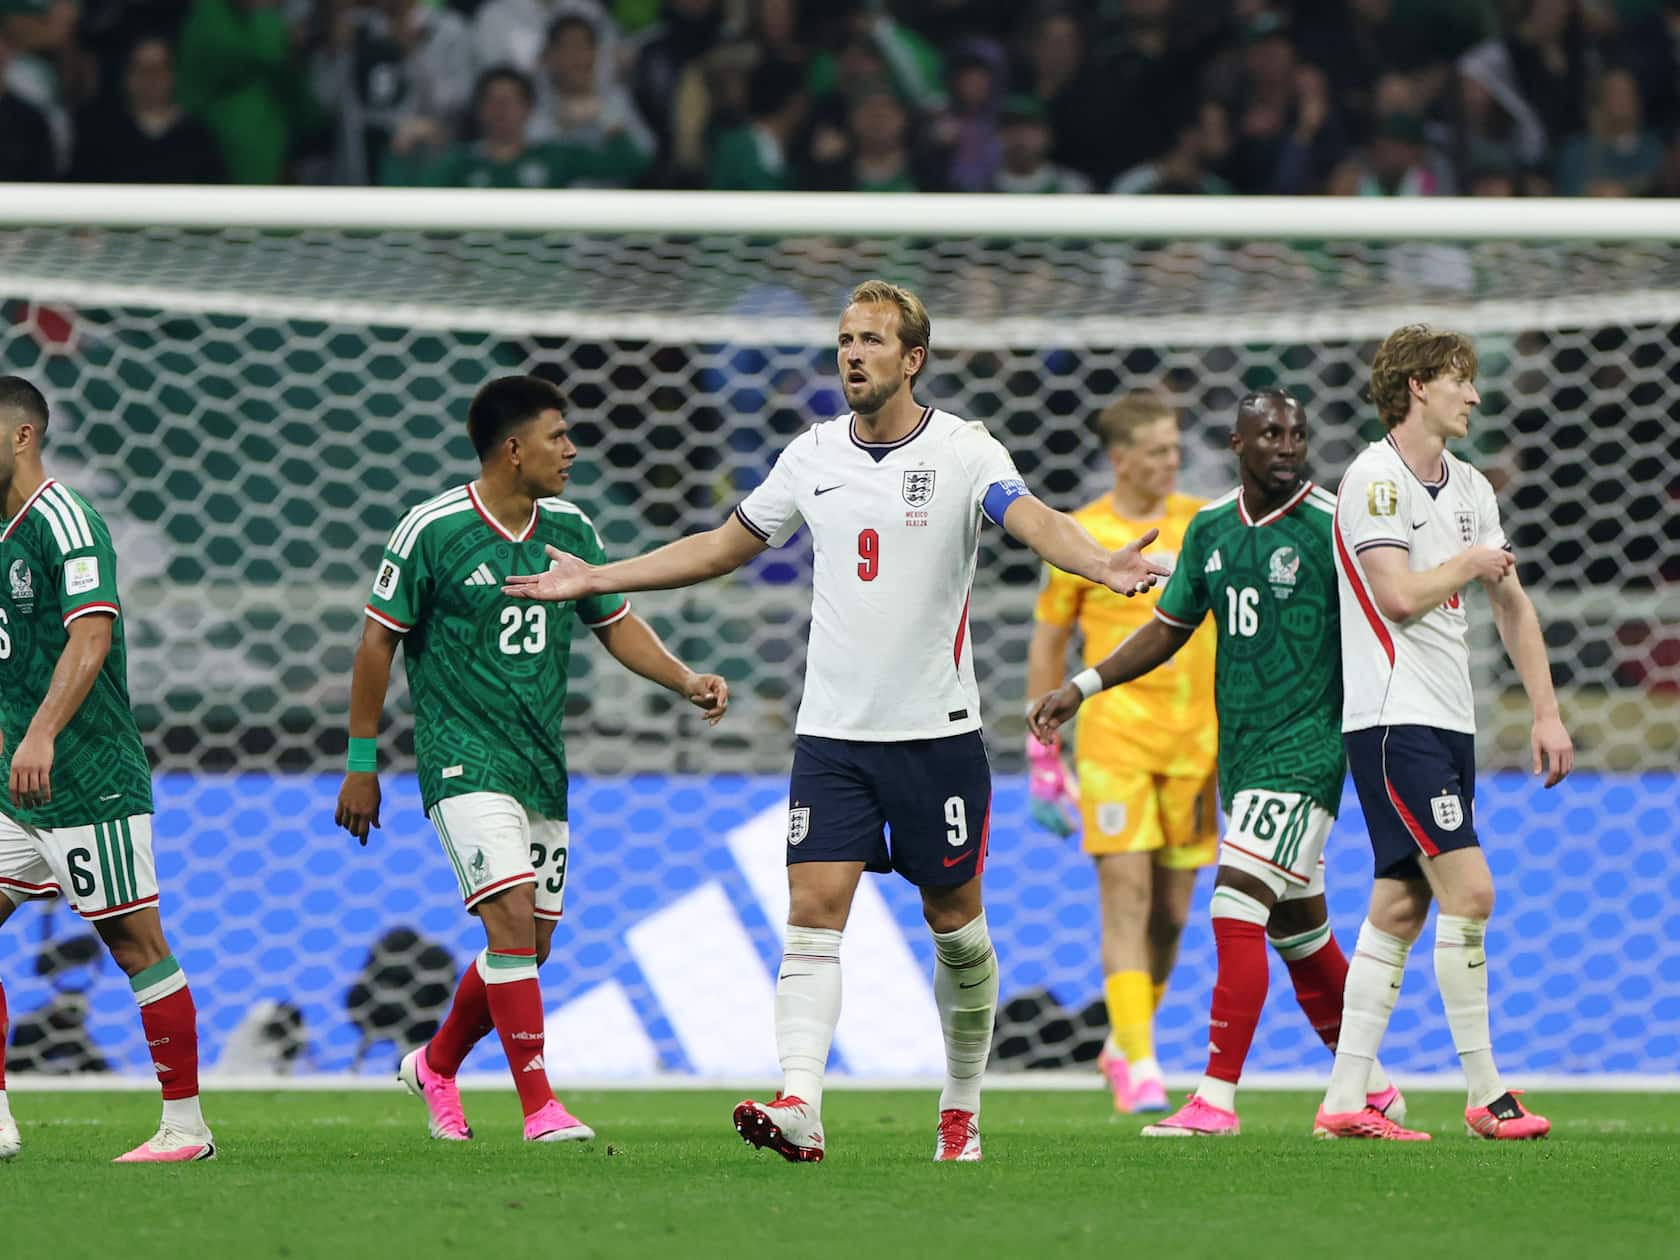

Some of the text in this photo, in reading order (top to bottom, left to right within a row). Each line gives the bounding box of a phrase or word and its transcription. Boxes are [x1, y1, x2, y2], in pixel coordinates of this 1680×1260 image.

[857, 528, 879, 582] 9
[500, 605, 546, 655] 23
[1226, 586, 1259, 637] 16
[943, 795, 969, 847] 9
[1239, 794, 1286, 841] 16
[66, 847, 96, 898] 6
